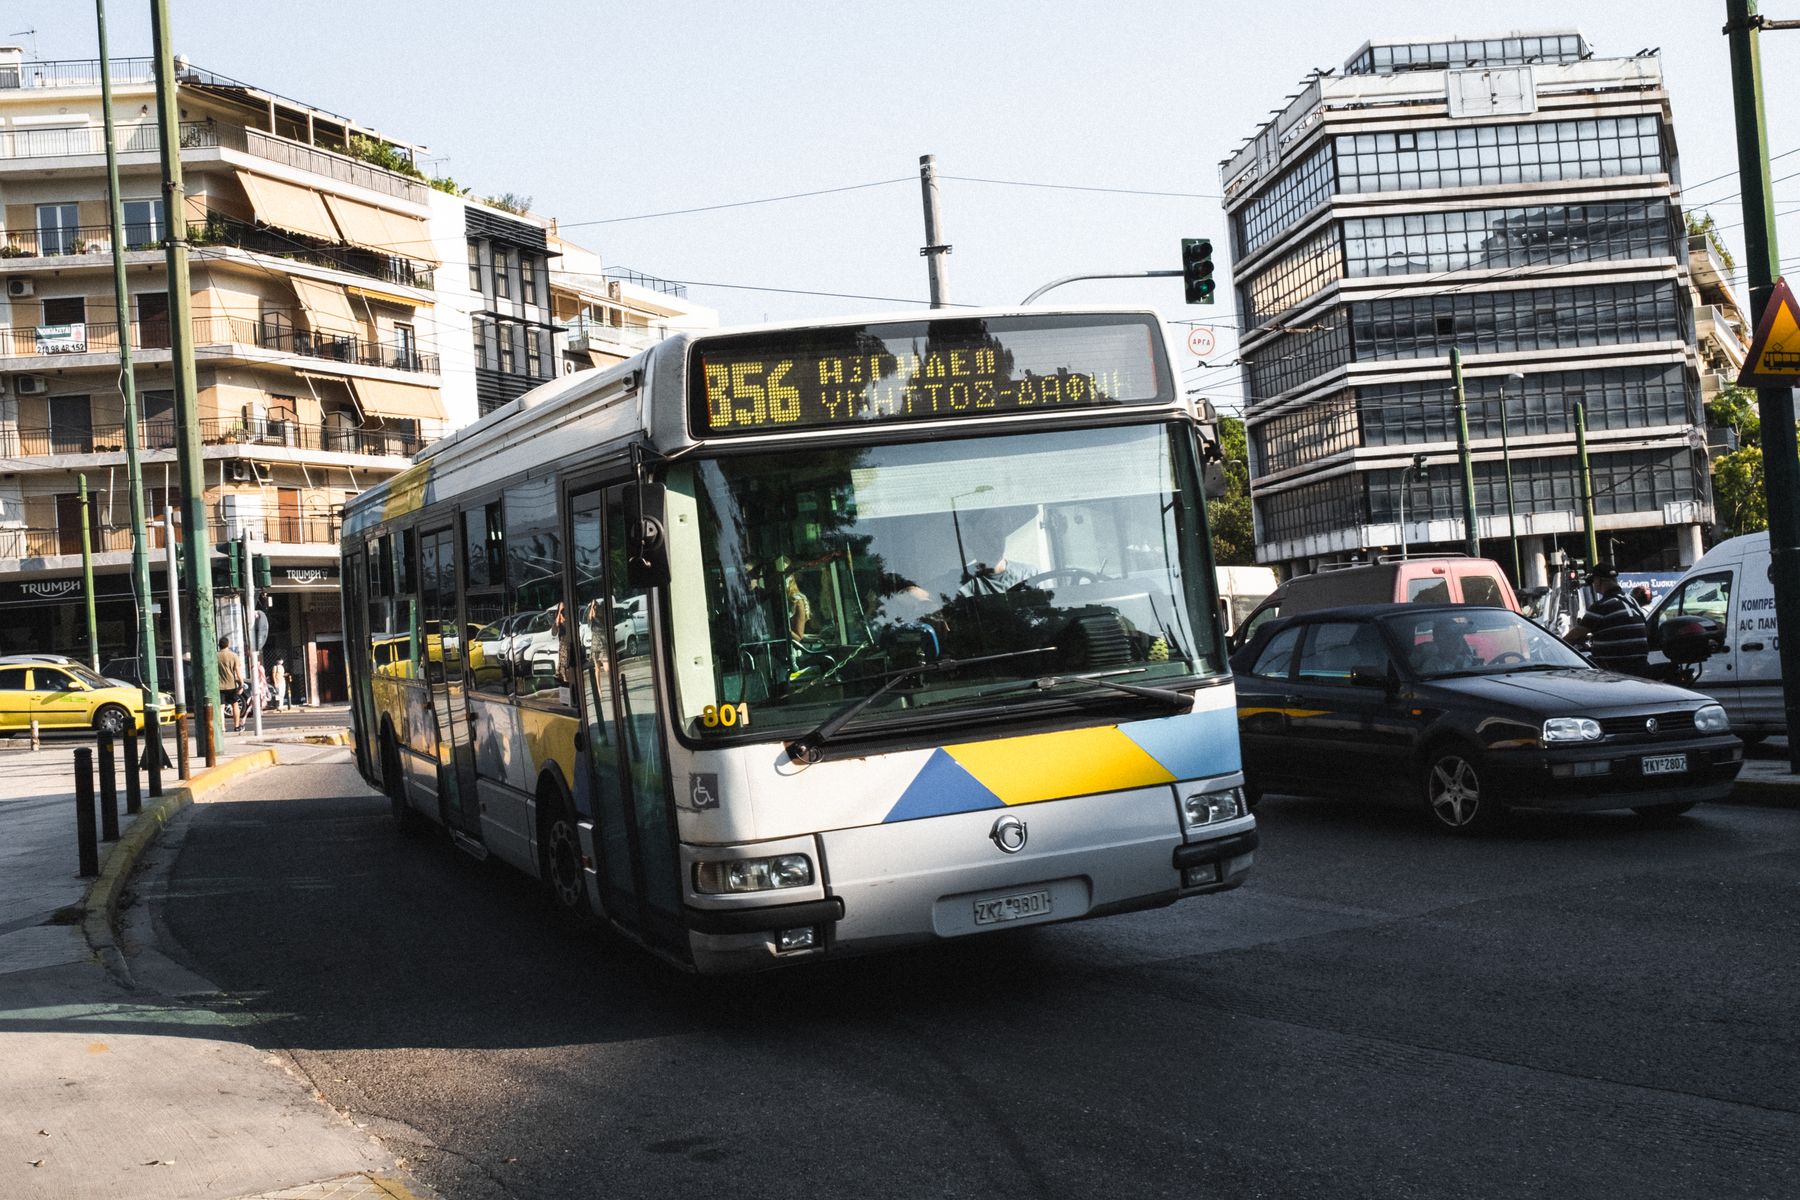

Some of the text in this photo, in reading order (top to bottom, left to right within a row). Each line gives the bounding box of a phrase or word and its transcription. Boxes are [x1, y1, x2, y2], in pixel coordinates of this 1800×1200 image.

[286, 569, 321, 584] TRIUMPH
[20, 580, 81, 597] TRIUMPH
[703, 702, 750, 728] 801
